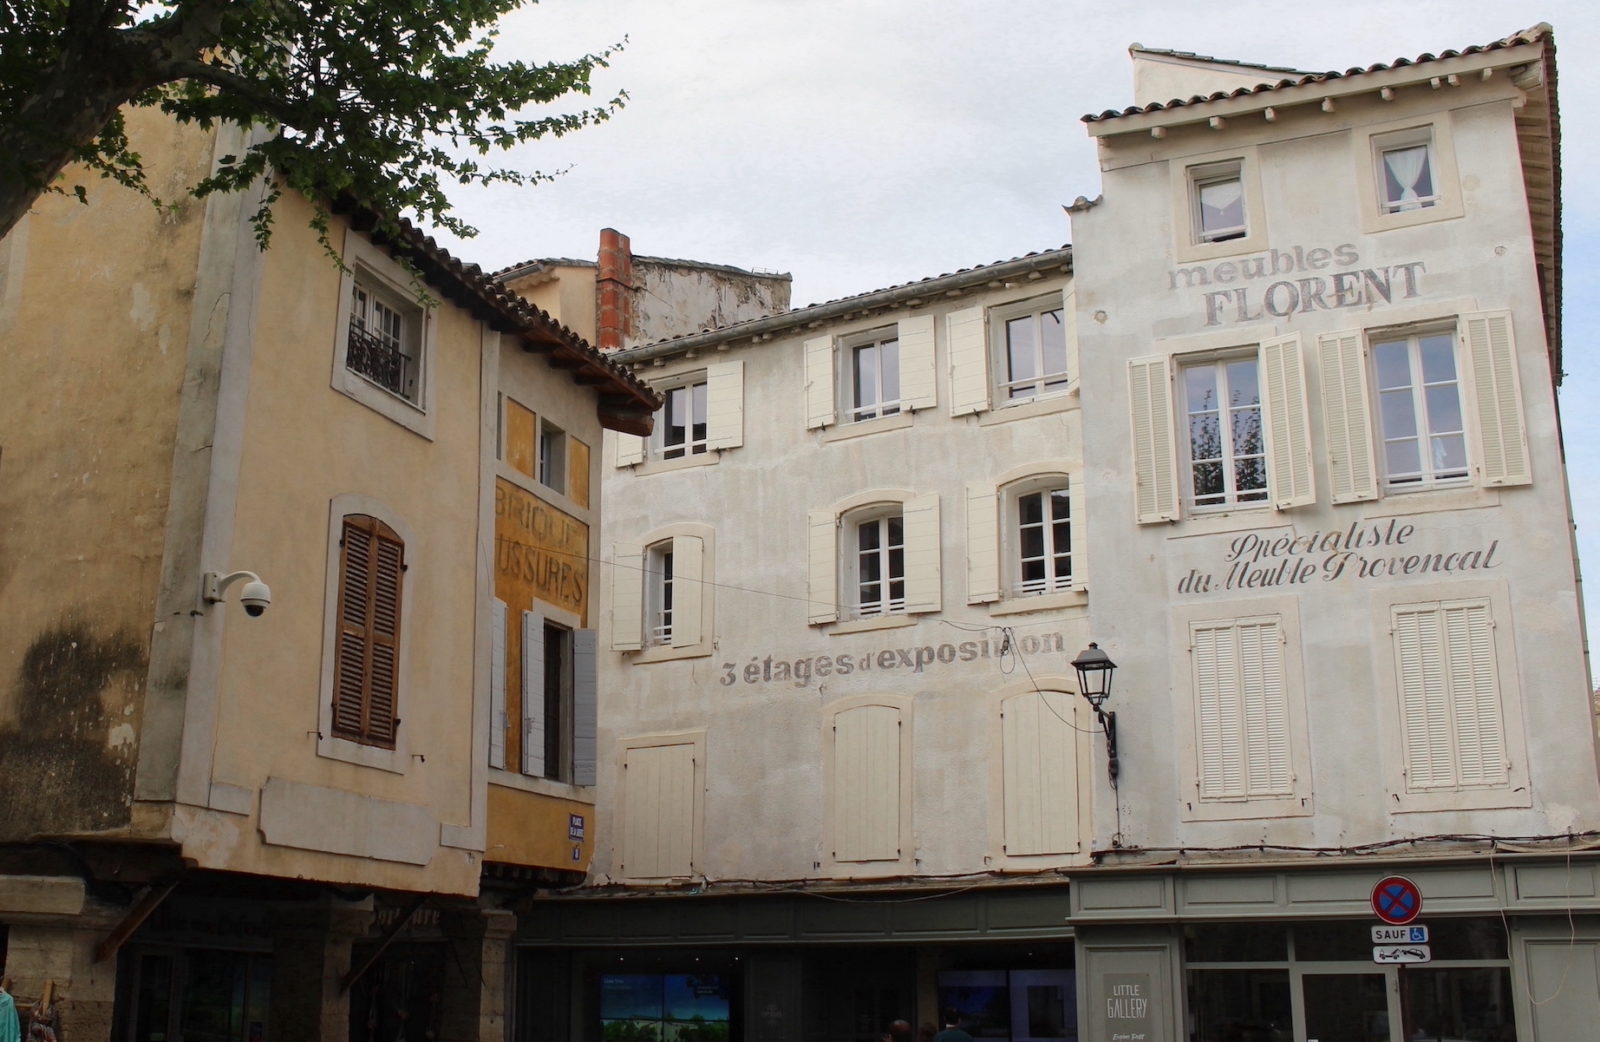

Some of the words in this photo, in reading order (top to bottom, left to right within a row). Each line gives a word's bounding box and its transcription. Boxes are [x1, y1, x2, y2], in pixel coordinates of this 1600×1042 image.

[1168, 243, 1359, 290] meubles
[1203, 261, 1425, 327] FLORENT
[1224, 518, 1414, 562] Spécialiste
[1177, 568, 1211, 594] du
[1215, 558, 1316, 591] Meuble
[1322, 540, 1504, 583] Provençal
[720, 661, 737, 687] 3
[743, 652, 854, 688] étages
[1375, 929, 1406, 940] SAUF
[1107, 998, 1147, 1019] GALLERY
[1113, 984, 1140, 996] LITTLE
